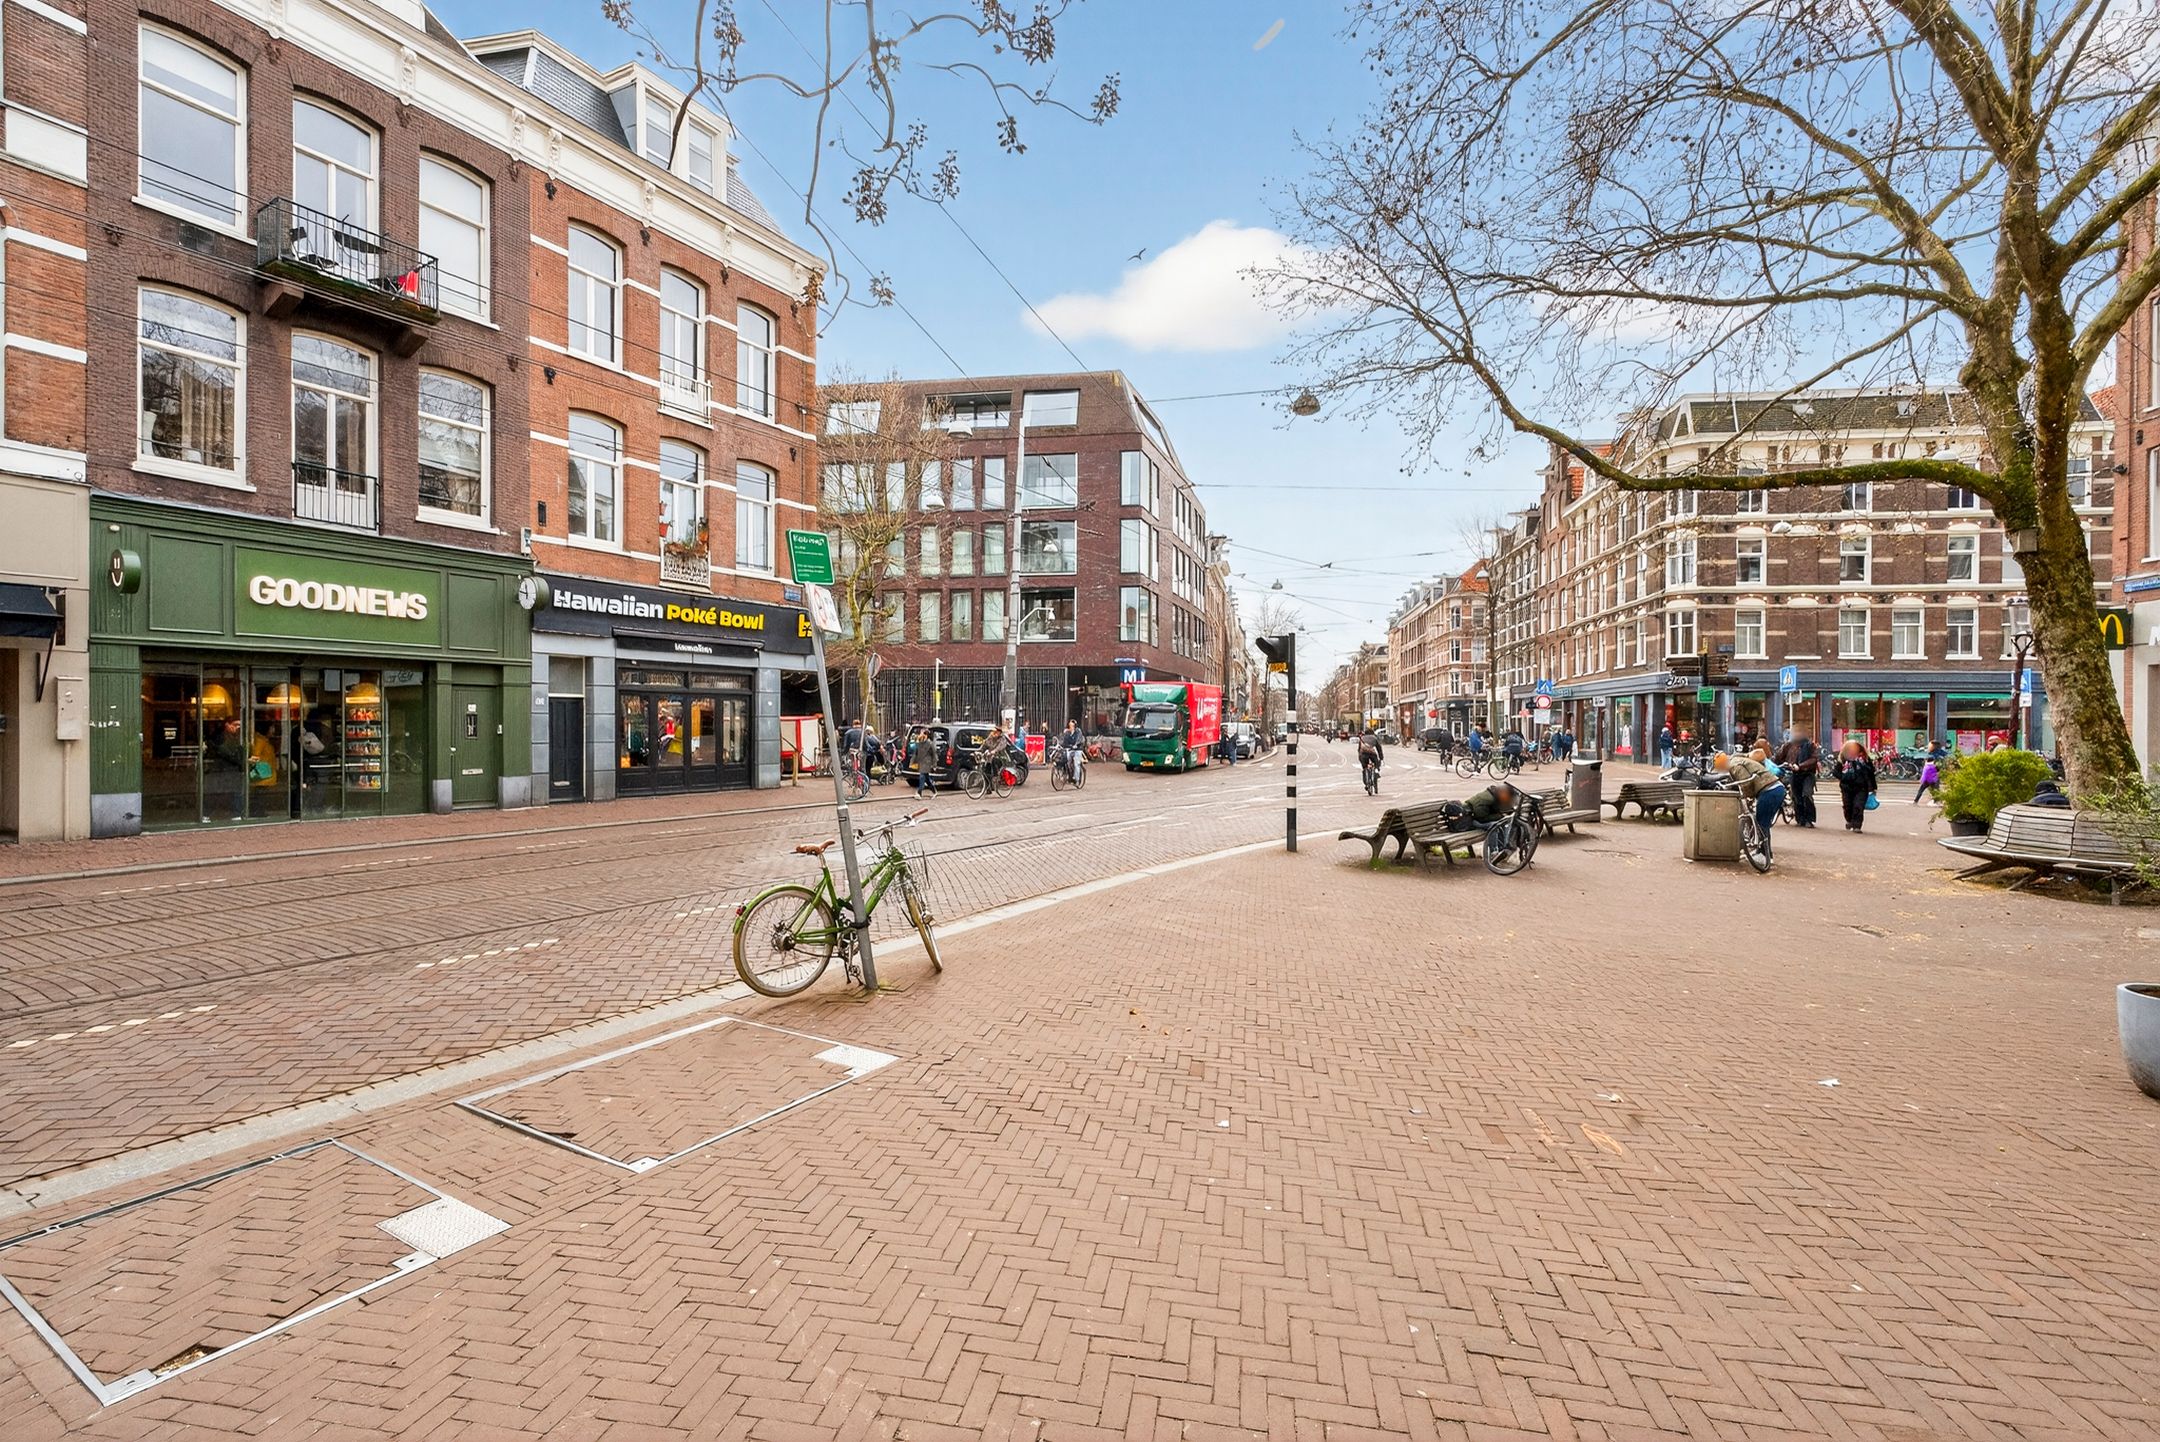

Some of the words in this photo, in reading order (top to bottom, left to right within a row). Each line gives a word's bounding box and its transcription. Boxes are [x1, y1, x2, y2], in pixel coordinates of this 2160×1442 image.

[250, 575, 428, 620] GOODNEWS
[553, 588, 664, 619] Hawaiian
[667, 605, 717, 624] Poké
[720, 610, 764, 630] Bowl
